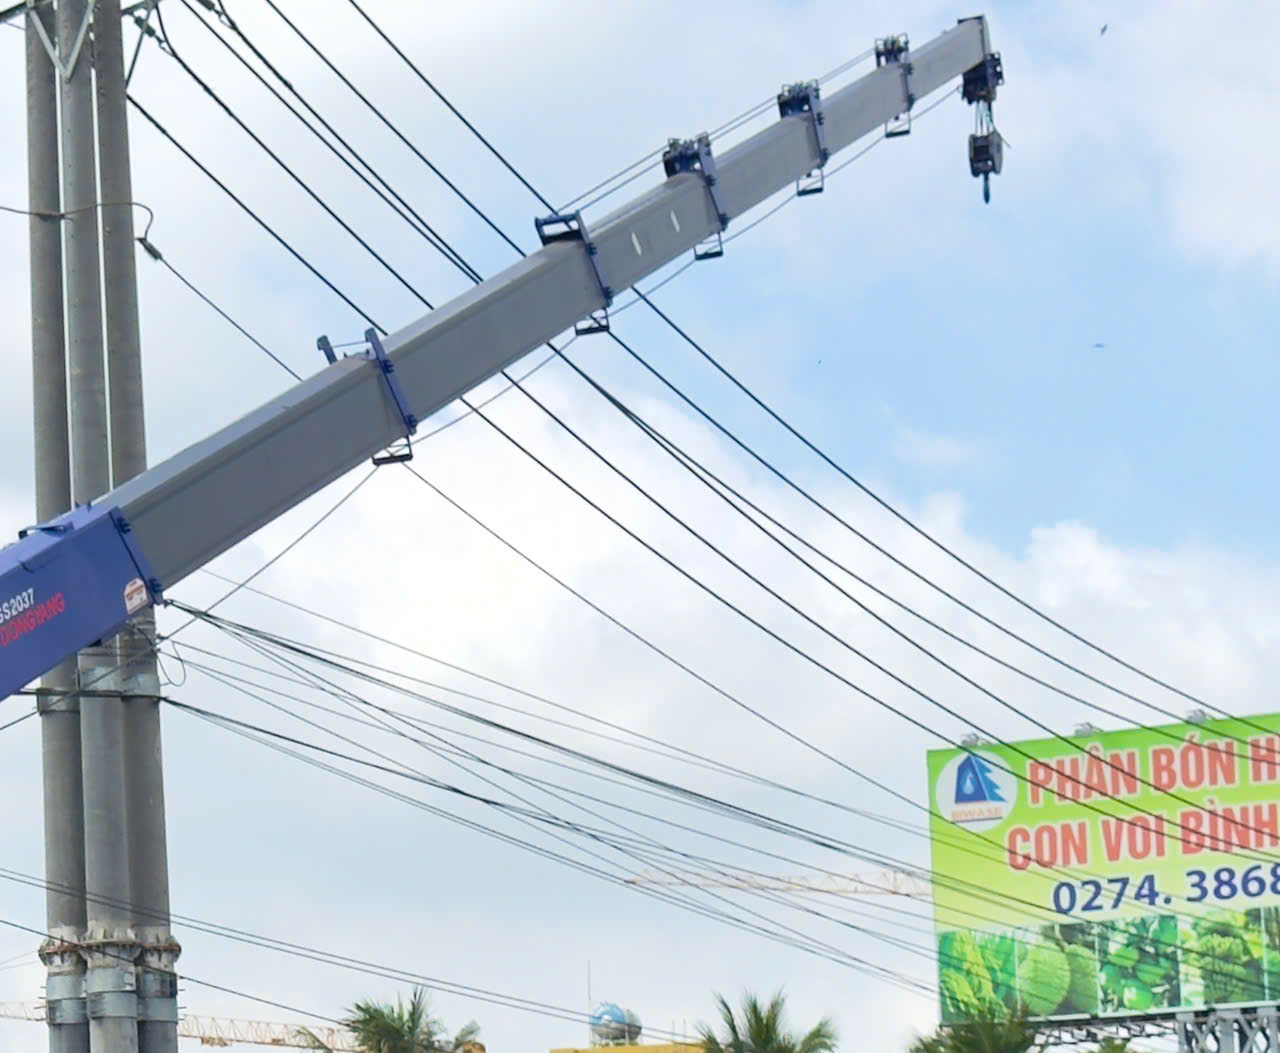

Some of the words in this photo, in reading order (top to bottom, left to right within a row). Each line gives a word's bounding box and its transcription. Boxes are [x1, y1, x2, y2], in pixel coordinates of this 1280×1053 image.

[0, 592, 65, 648] DONGYANG
[1029, 745, 1137, 804] PHÂN
[1152, 734, 1235, 787] BÓN
[1008, 820, 1088, 870] CON
[1102, 812, 1165, 862] VOI
[1180, 798, 1278, 855] BÌNH
[1053, 874, 1172, 915] 0274.
